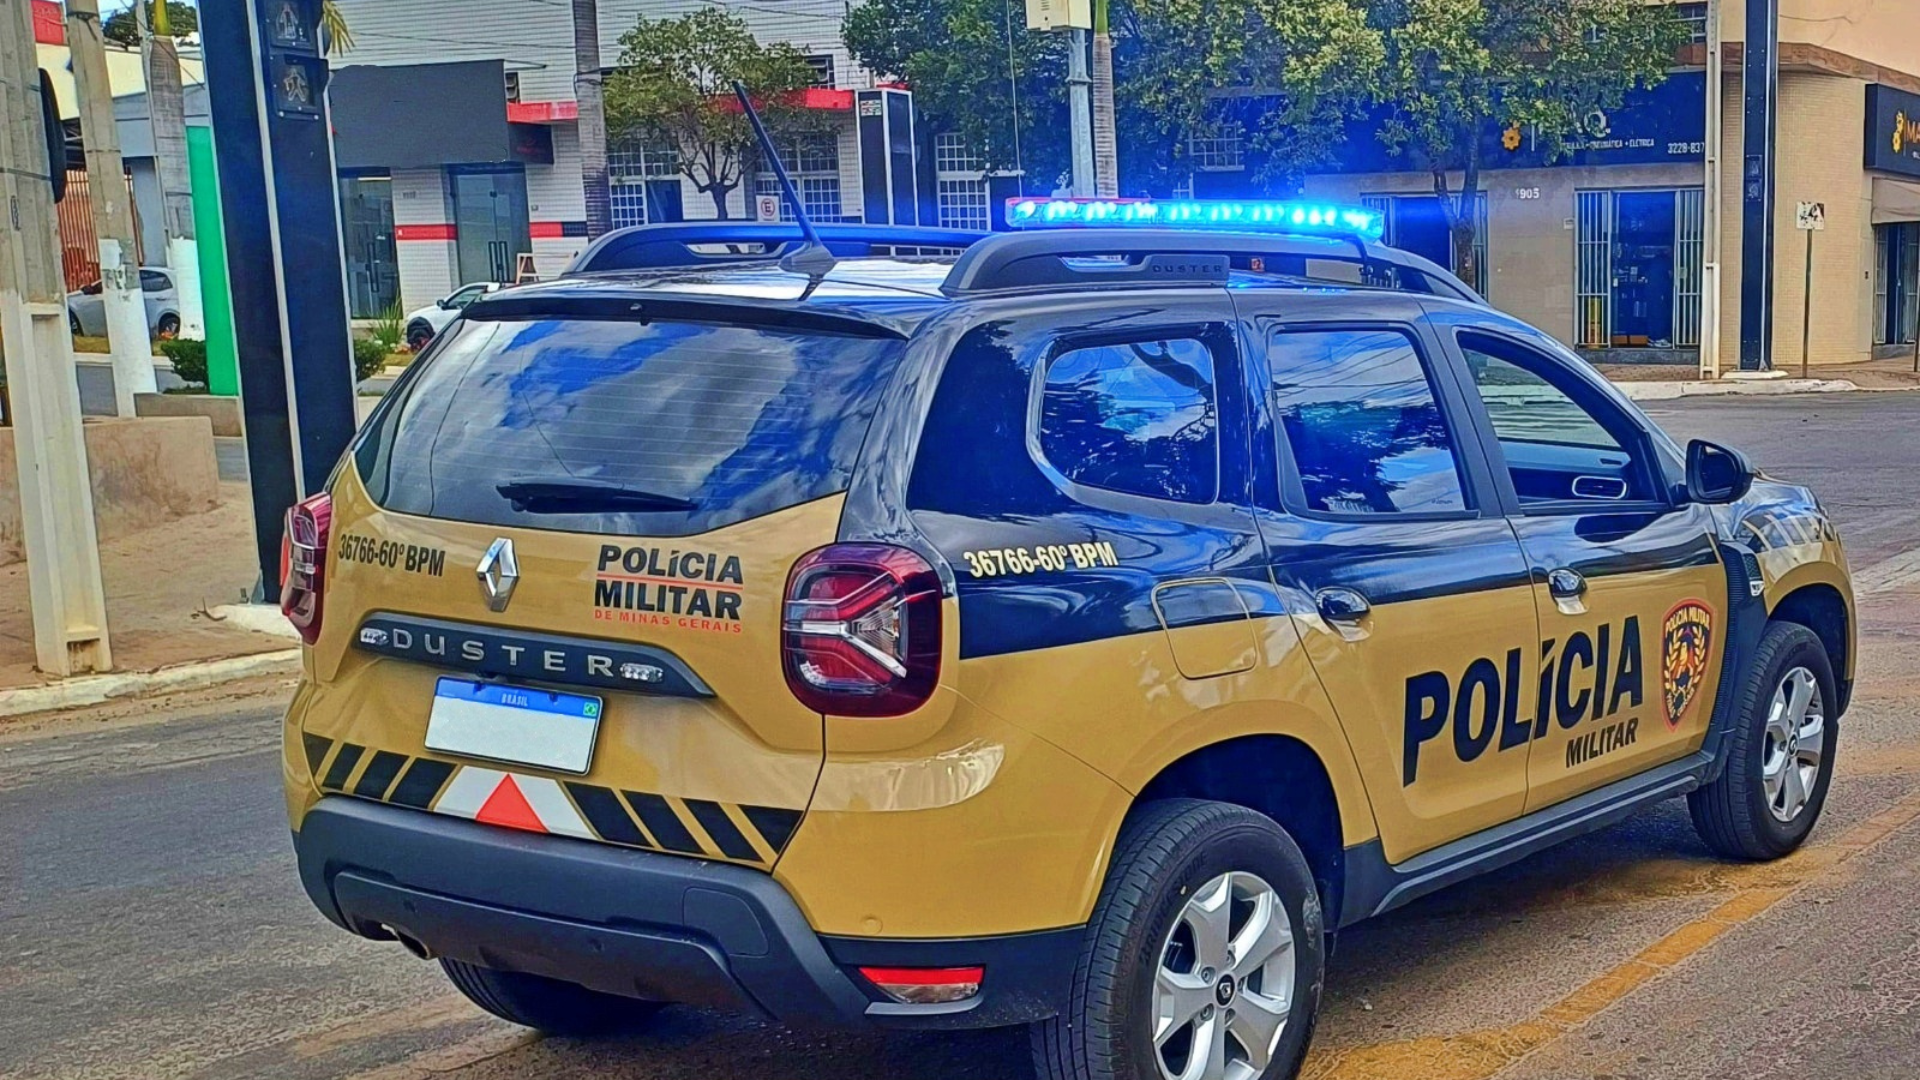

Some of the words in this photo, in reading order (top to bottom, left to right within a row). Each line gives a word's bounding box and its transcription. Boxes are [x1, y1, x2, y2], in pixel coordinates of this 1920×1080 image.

[1667, 142, 1705, 155] 3228-837
[1152, 264, 1222, 273] DUSTER
[405, 545, 446, 577] BPM
[597, 544, 743, 584] POLÍCIA
[1067, 541, 1119, 569] BPM
[594, 579, 742, 620] MILITAR
[594, 610, 612, 620] DE
[619, 612, 670, 625] MINAS
[678, 618, 742, 633] GERAIS
[393, 629, 614, 677] DUSTER
[1403, 615, 1643, 788] POLÍCIA
[1566, 717, 1639, 769] MILITAR
